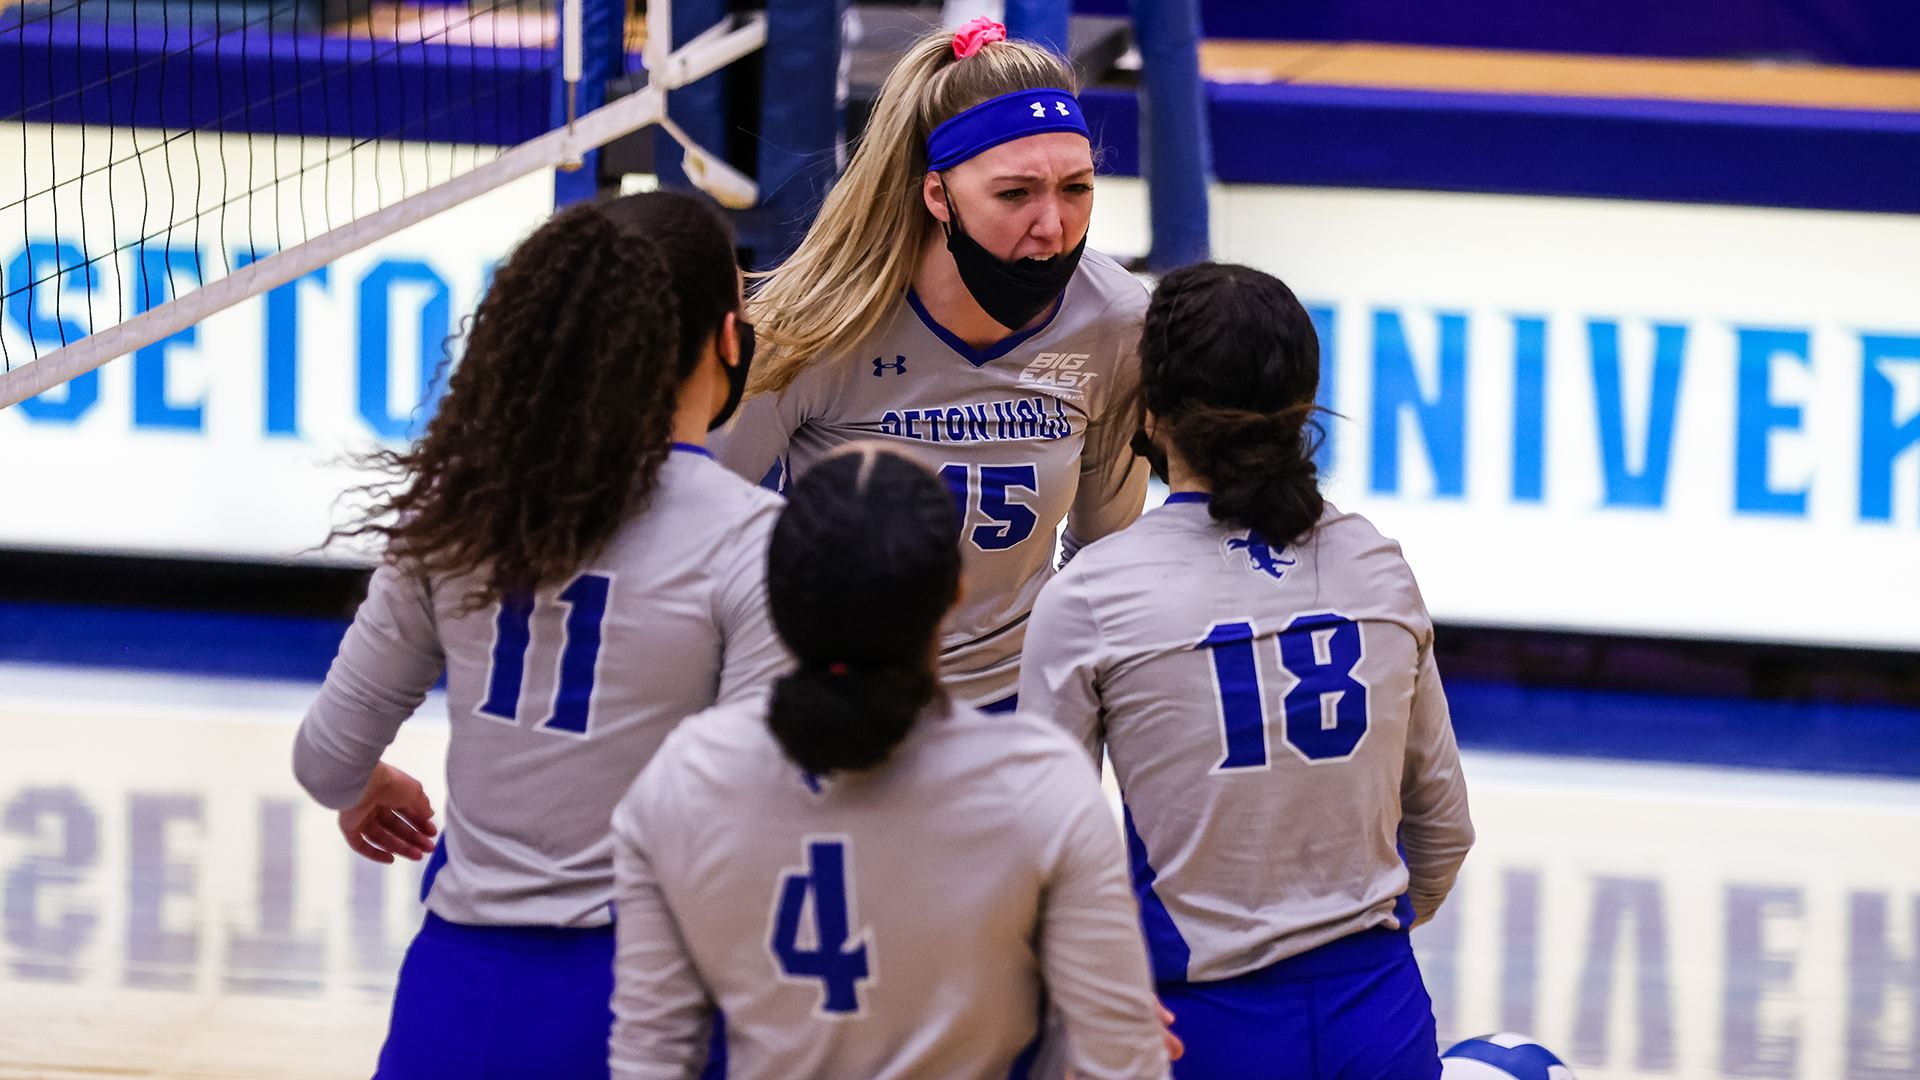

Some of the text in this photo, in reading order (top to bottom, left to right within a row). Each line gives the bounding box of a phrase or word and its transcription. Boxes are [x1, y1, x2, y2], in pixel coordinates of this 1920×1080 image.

[4, 239, 498, 441] SETO
[1018, 367, 1099, 388] EAST
[1027, 352, 1090, 370] BIG
[993, 397, 1072, 442] HALL
[936, 461, 1040, 552] 15
[471, 569, 616, 741] 11
[1193, 608, 1371, 776] 18
[765, 833, 878, 1021] 4
